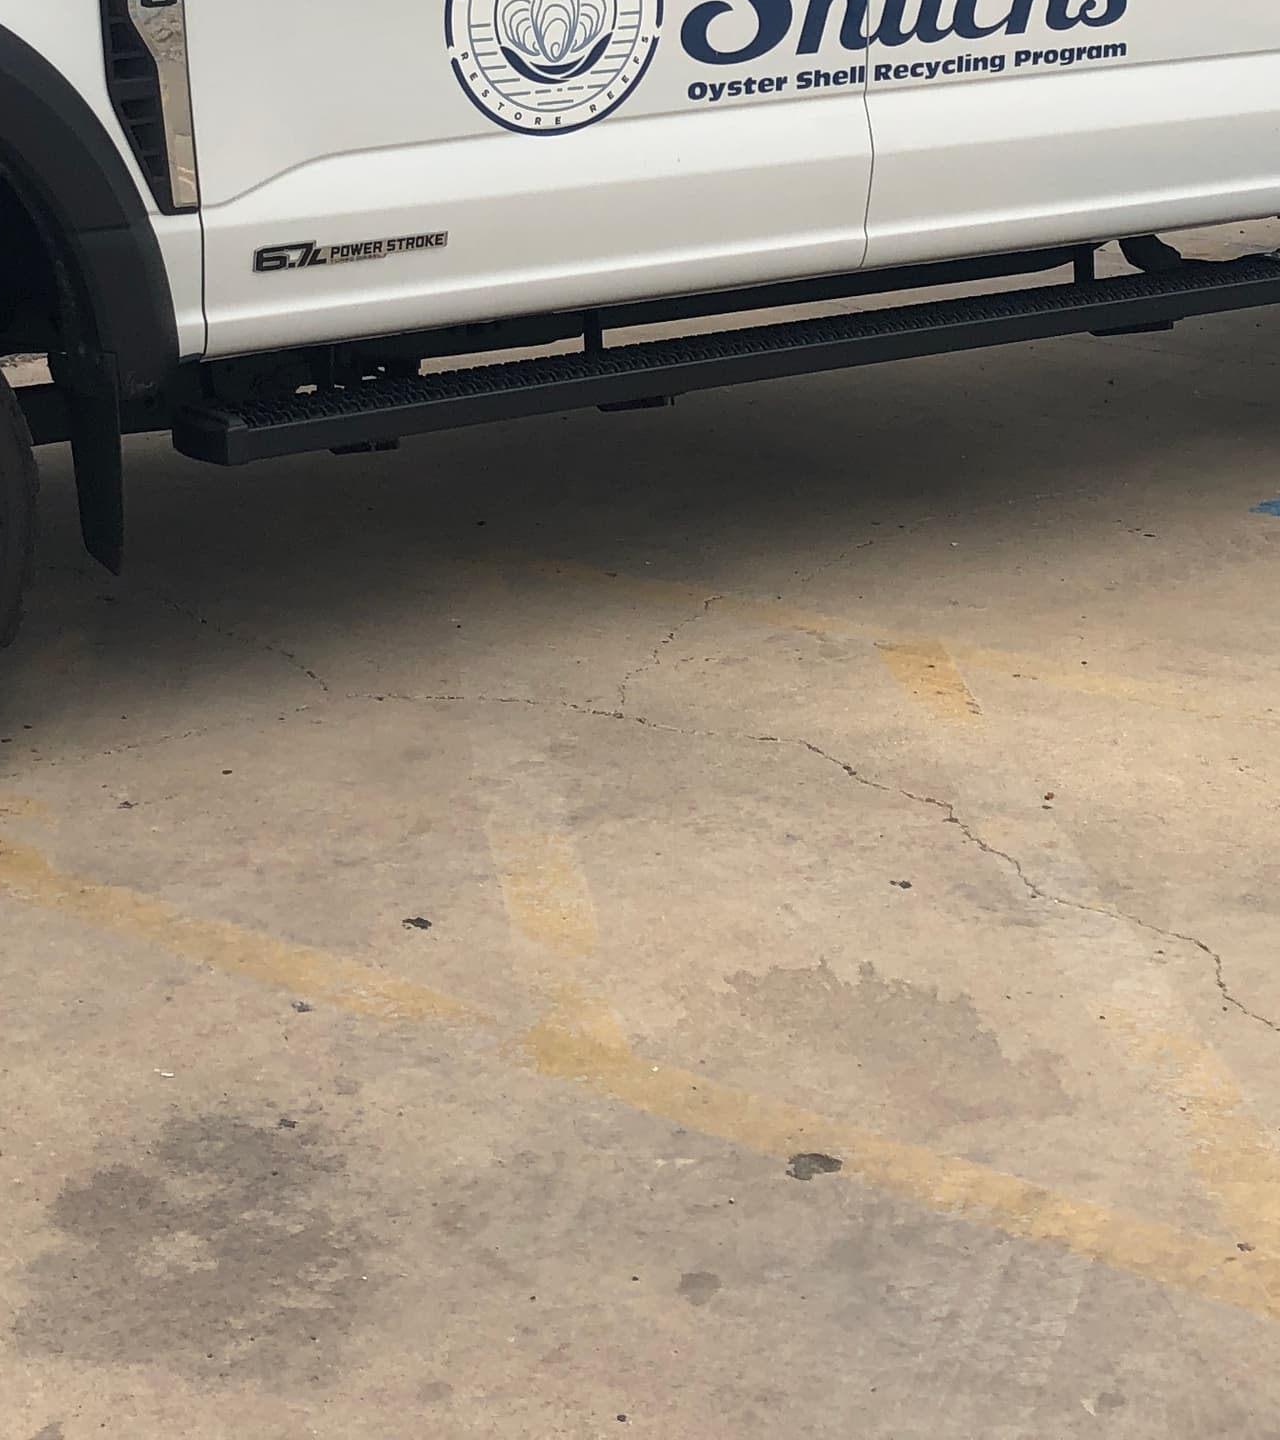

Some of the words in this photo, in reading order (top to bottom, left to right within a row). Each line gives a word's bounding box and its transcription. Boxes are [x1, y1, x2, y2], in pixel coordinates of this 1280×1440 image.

[461, 51, 562, 126] RESTORE
[589, 36, 650, 113] REEFS
[687, 74, 788, 102] Oyster
[796, 65, 866, 90] Shell
[874, 53, 1005, 82] Recycling
[1014, 42, 1127, 67] Program
[256, 242, 327, 271] 6.7L
[330, 241, 383, 259] POWER
[386, 233, 445, 252] STROKE
